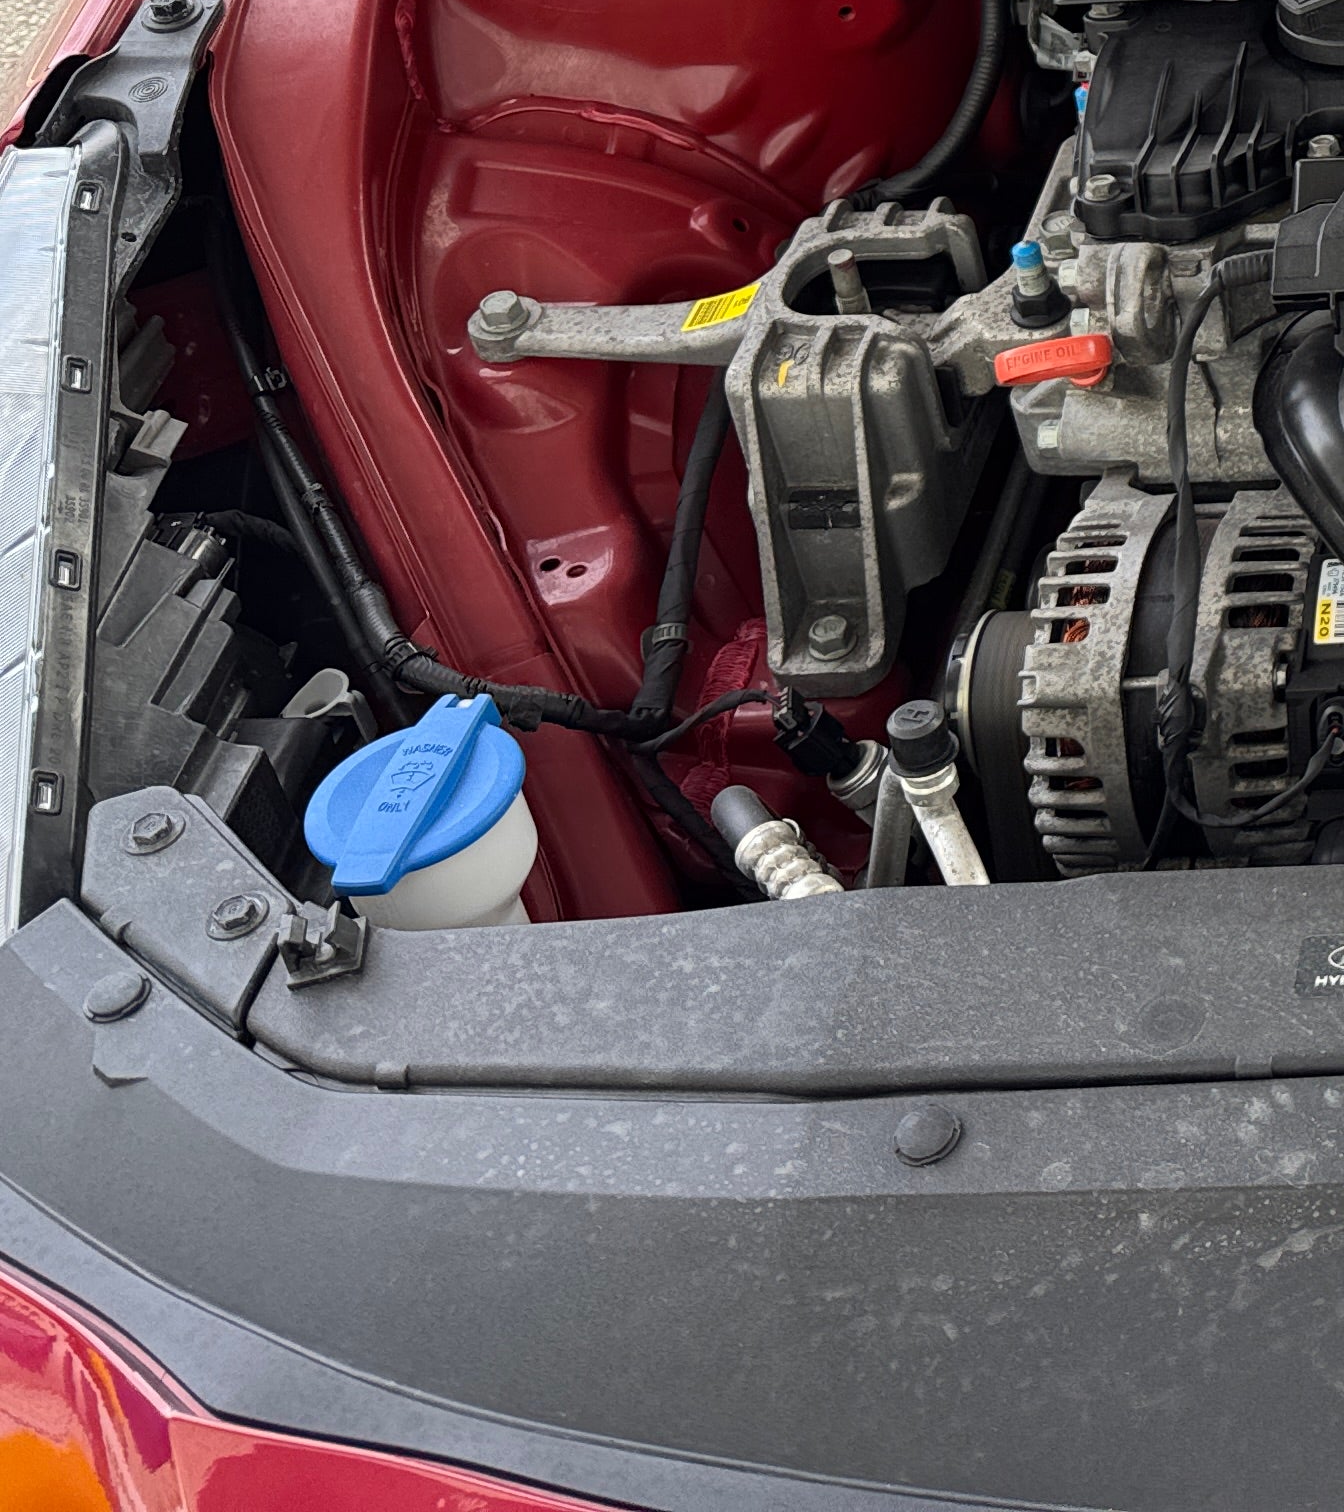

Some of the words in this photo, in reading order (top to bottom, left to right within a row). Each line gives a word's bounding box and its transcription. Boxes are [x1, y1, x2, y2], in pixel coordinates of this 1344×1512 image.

[1006, 348, 1052, 371] ENGINE
[1055, 344, 1081, 359] OIL
[1319, 603, 1332, 637] N20
[402, 743, 455, 757] WASHER
[377, 799, 410, 813] ONLY
